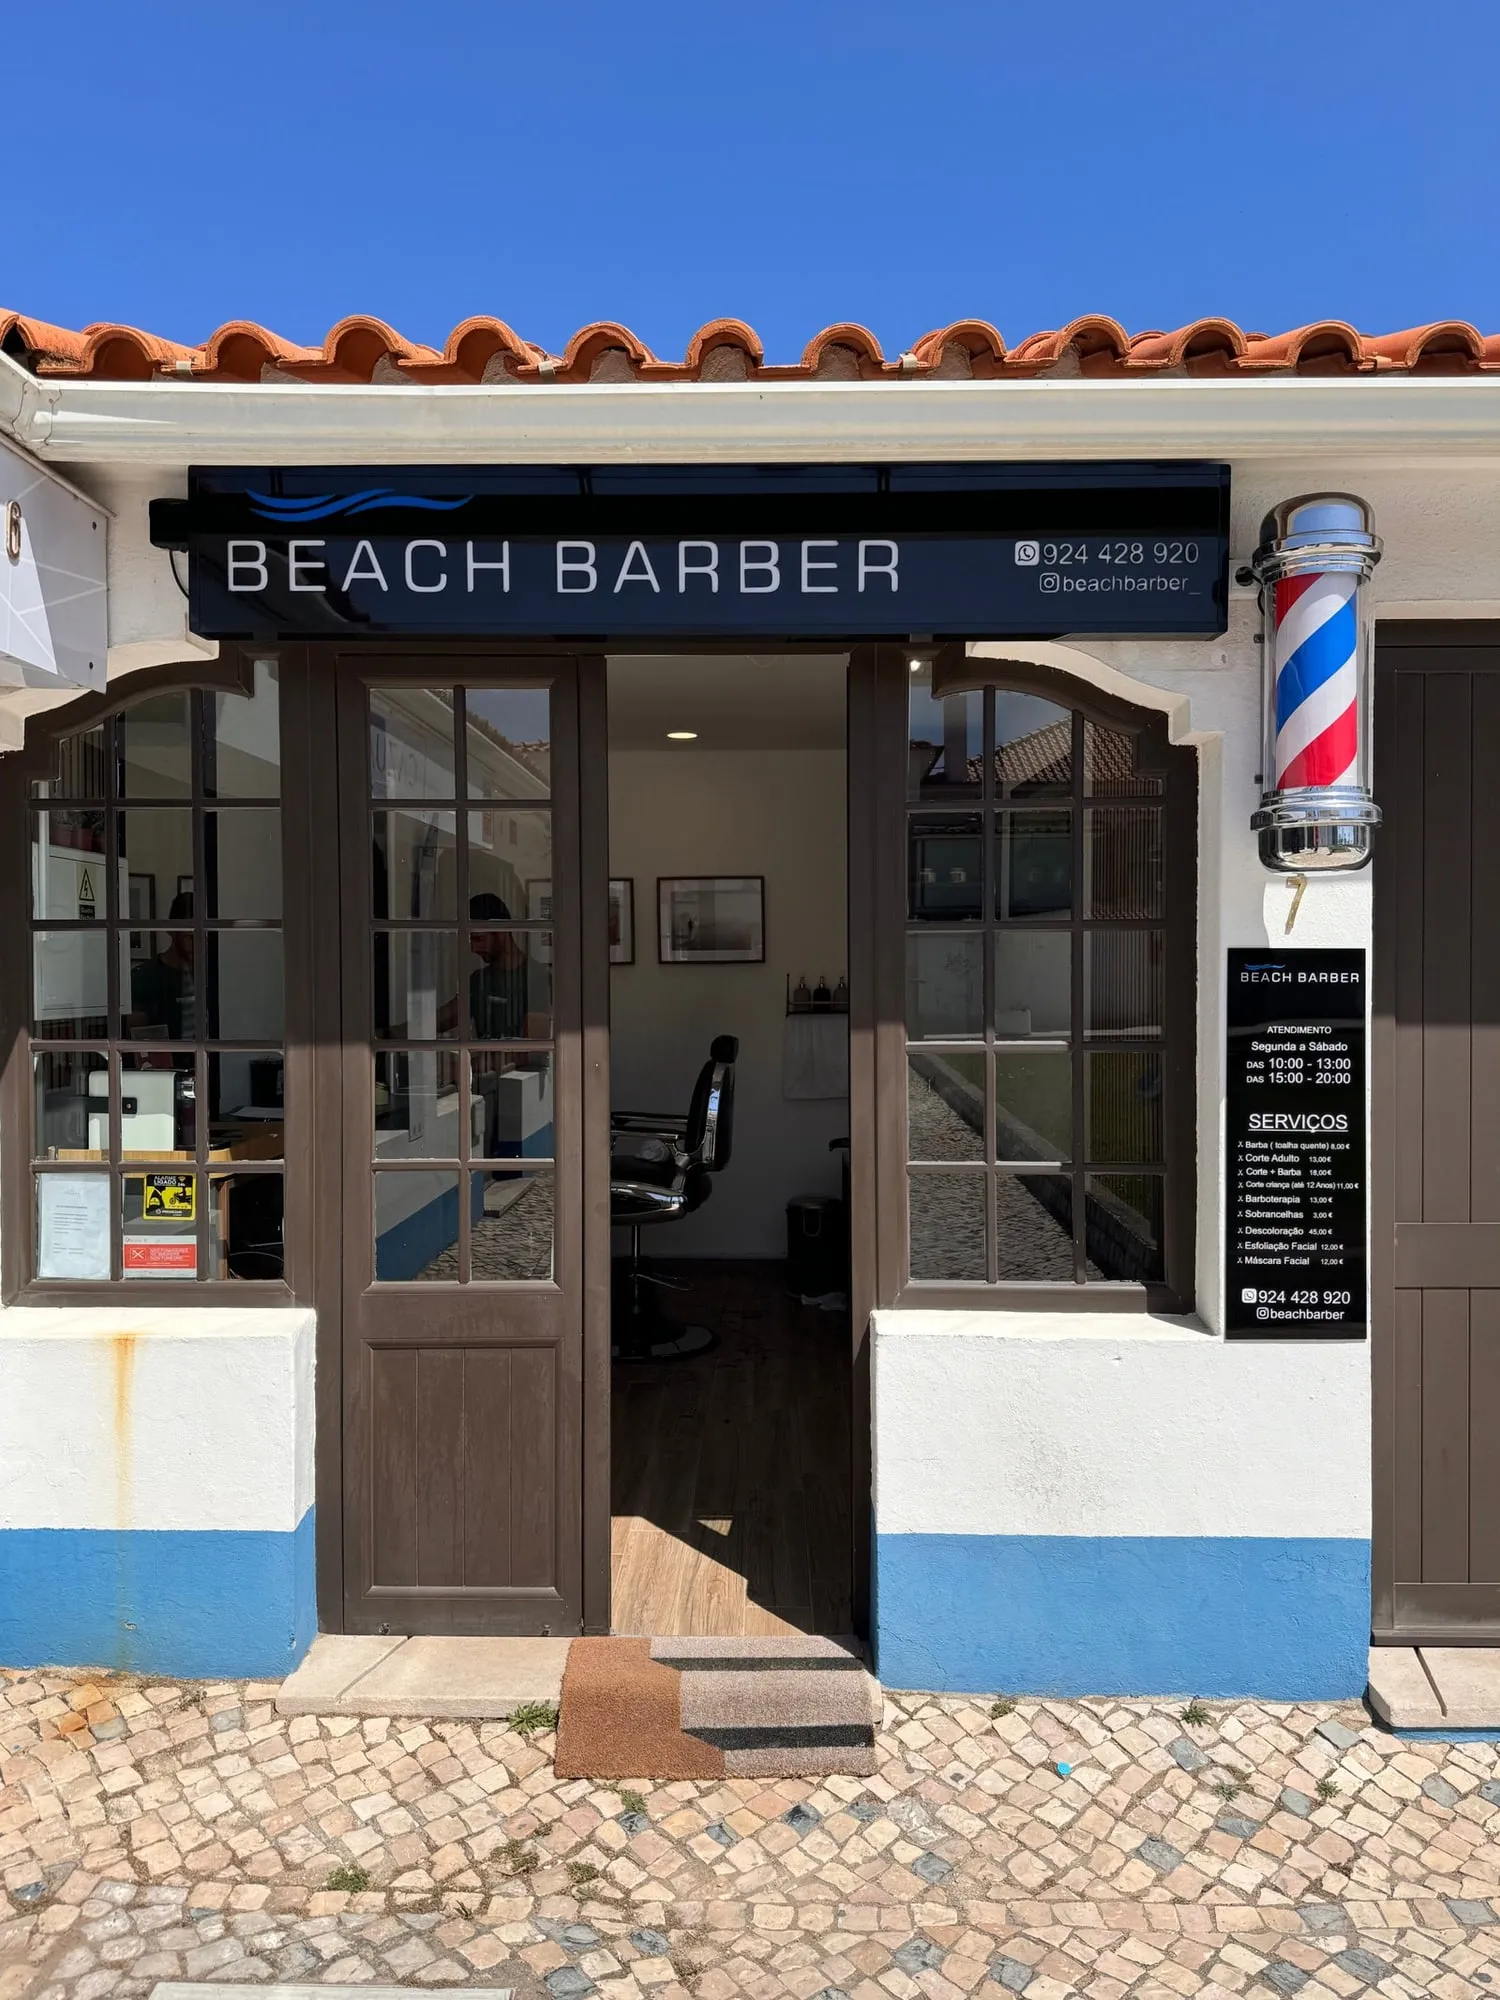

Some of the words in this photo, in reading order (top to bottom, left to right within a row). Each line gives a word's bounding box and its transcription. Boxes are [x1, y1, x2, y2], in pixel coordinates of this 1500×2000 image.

[6, 500, 22, 560] 6
[1044, 544, 1088, 565] 924
[1098, 543, 1143, 564] 428
[1154, 543, 1198, 564] 920
[228, 540, 510, 592] BEACH
[557, 540, 898, 593] BARBER
[1284, 873, 1308, 935] 7
[1241, 972, 1291, 982] BEACH
[1298, 972, 1359, 983] BARBER
[1267, 1026, 1331, 1034] ATENDIMENTO
[1251, 1041, 1296, 1053] Segunda
[1309, 1042, 1348, 1051] Sábado
[1269, 1058, 1303, 1069] 10:00
[1317, 1058, 1351, 1069] 13:00
[1269, 1072, 1303, 1083] 15:00
[1316, 1072, 1351, 1084] 20:00
[1248, 1114, 1348, 1133] SERVIÇOS
[1300, 1142, 1329, 1150] quente)
[1245, 1154, 1270, 1162] Corte
[1271, 1154, 1300, 1162] Adulto
[1246, 1167, 1268, 1175] Corte
[1278, 1168, 1301, 1176] Barba
[1266, 1181, 1290, 1189] criança
[1291, 1181, 1304, 1189] (até
[1315, 1182, 1336, 1190] Anos)
[1245, 1194, 1300, 1205] Barboterapia
[1245, 1210, 1304, 1218] Sobrancelhas
[1245, 1226, 1304, 1236] Descoloração
[1245, 1241, 1289, 1251] Esfoliação
[1292, 1242, 1317, 1250] Facial
[1245, 1256, 1281, 1264] Máscara
[1284, 1257, 1309, 1265] Facial
[1259, 1290, 1286, 1303] 924
[1291, 1291, 1318, 1304] 428
[1323, 1291, 1350, 1304] 920
[1270, 1308, 1344, 1320] beachbarber
